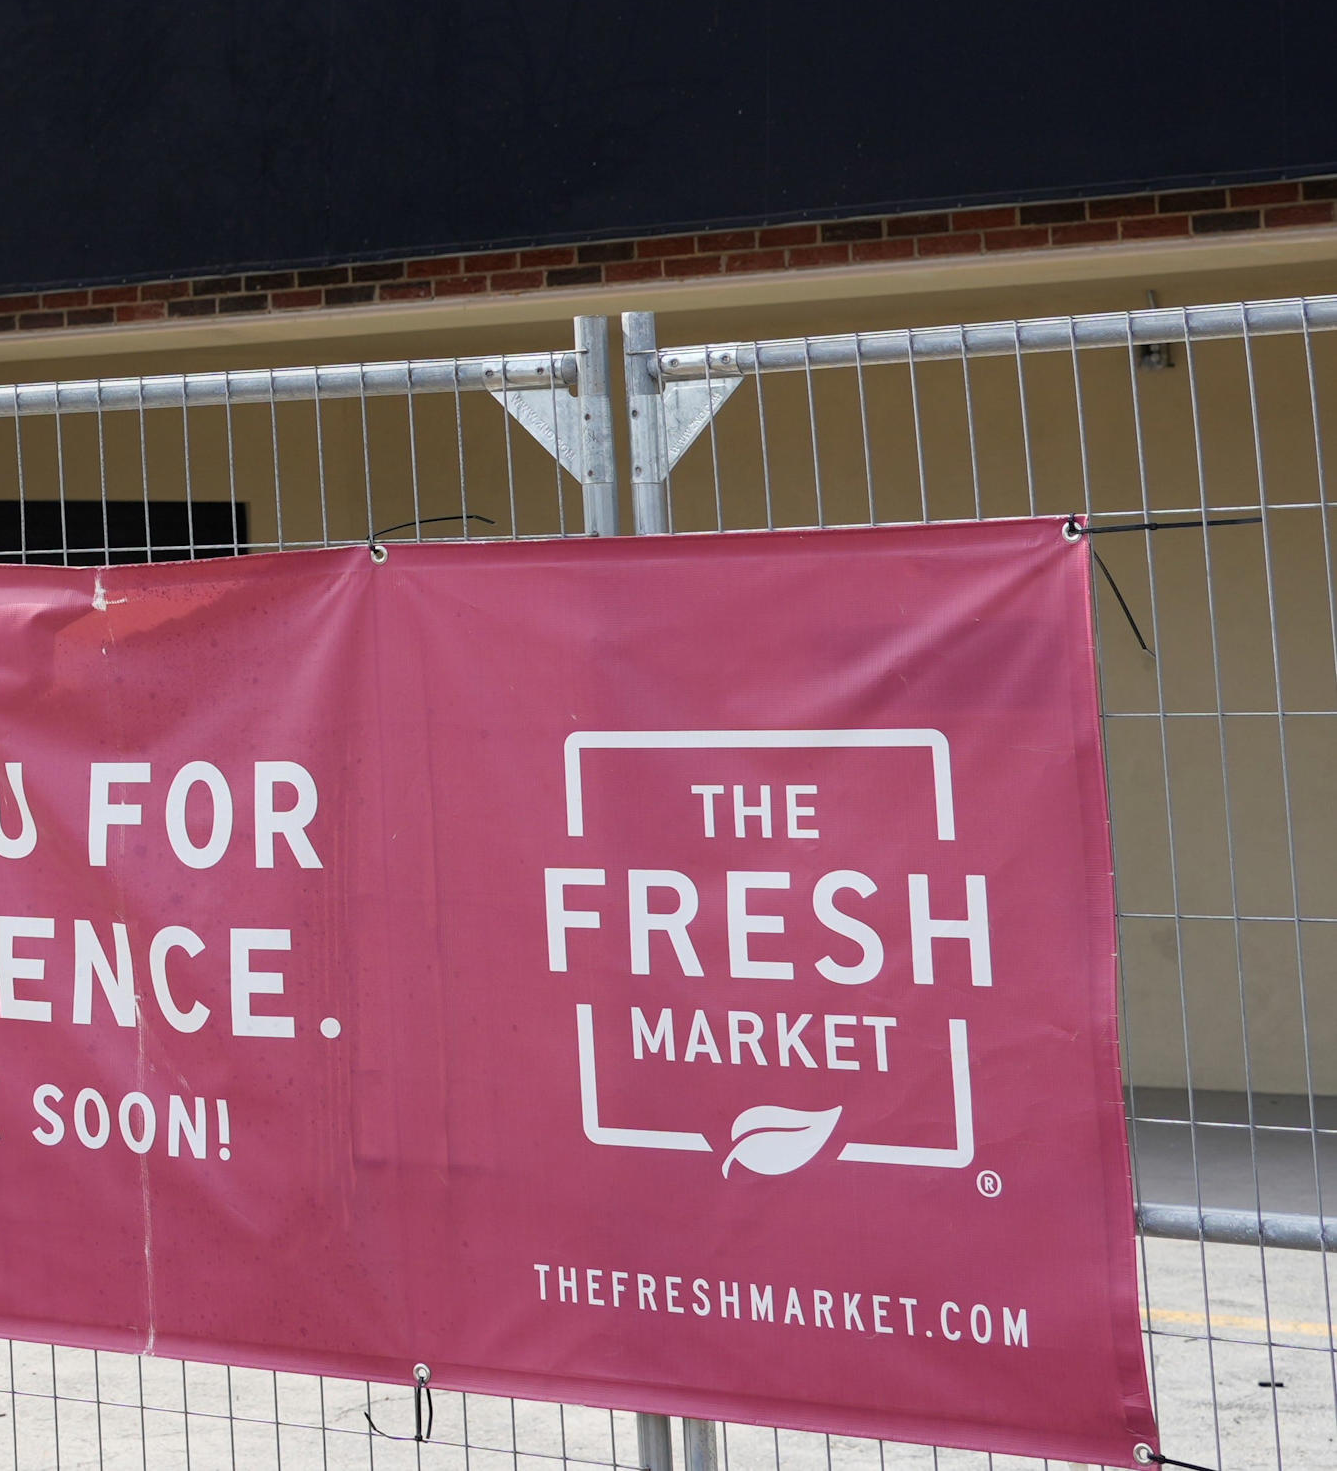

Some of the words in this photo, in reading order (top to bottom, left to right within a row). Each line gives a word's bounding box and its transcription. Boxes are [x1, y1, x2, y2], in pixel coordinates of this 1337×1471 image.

[88, 760, 324, 870] FOR
[690, 784, 821, 839] THE
[543, 866, 994, 988] FRESH
[630, 1006, 898, 1073] MARKET
[32, 1083, 231, 1160] SOON!
[533, 1264, 1029, 1349] THEFRESHMARKET.COM
